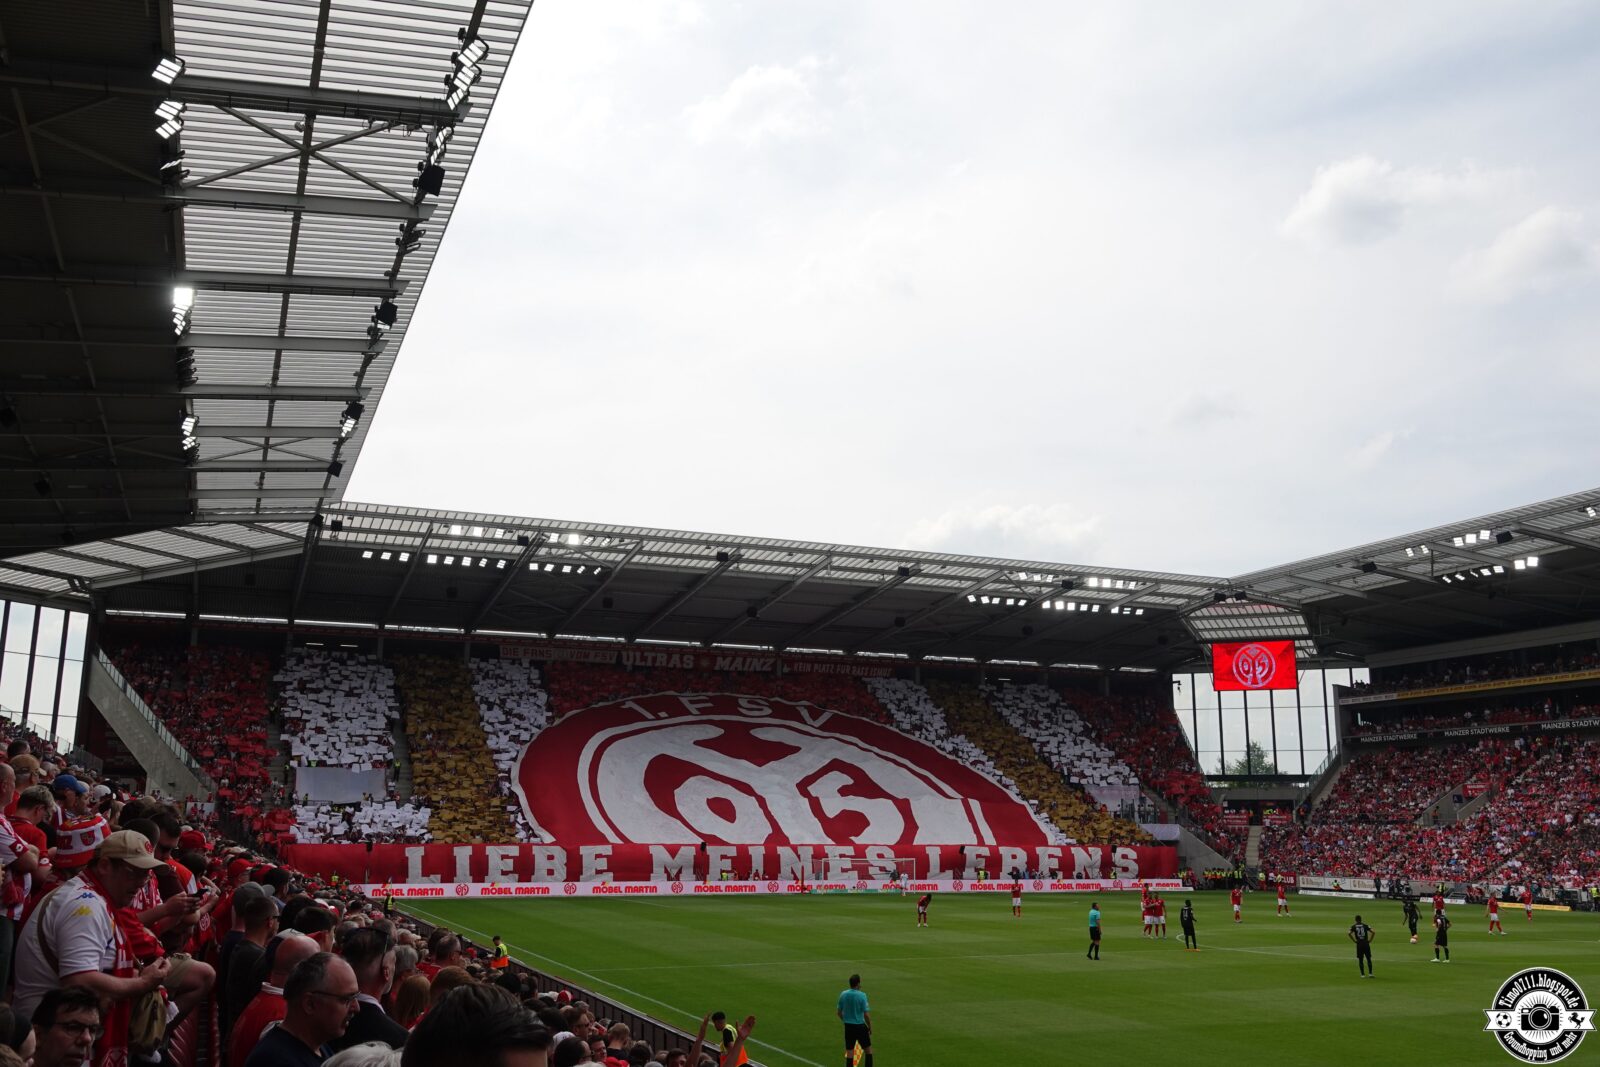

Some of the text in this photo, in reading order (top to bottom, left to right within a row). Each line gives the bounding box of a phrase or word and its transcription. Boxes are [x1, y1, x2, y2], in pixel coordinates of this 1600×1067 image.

[502, 647, 519, 657] DIE
[621, 650, 776, 672] ULTRAS MAINZ
[1541, 720, 1571, 729] MAINZER
[1444, 726, 1511, 737] MAINZER STADTWERKE
[1383, 733, 1418, 741] STADTWERKE
[405, 845, 1139, 884] LIEBE MEINES LEBENS
[407, 887, 444, 896] MARTIN
[514, 886, 550, 895] MARTIN
[624, 885, 658, 893] MARTIN
[724, 884, 756, 893] MARTIN
